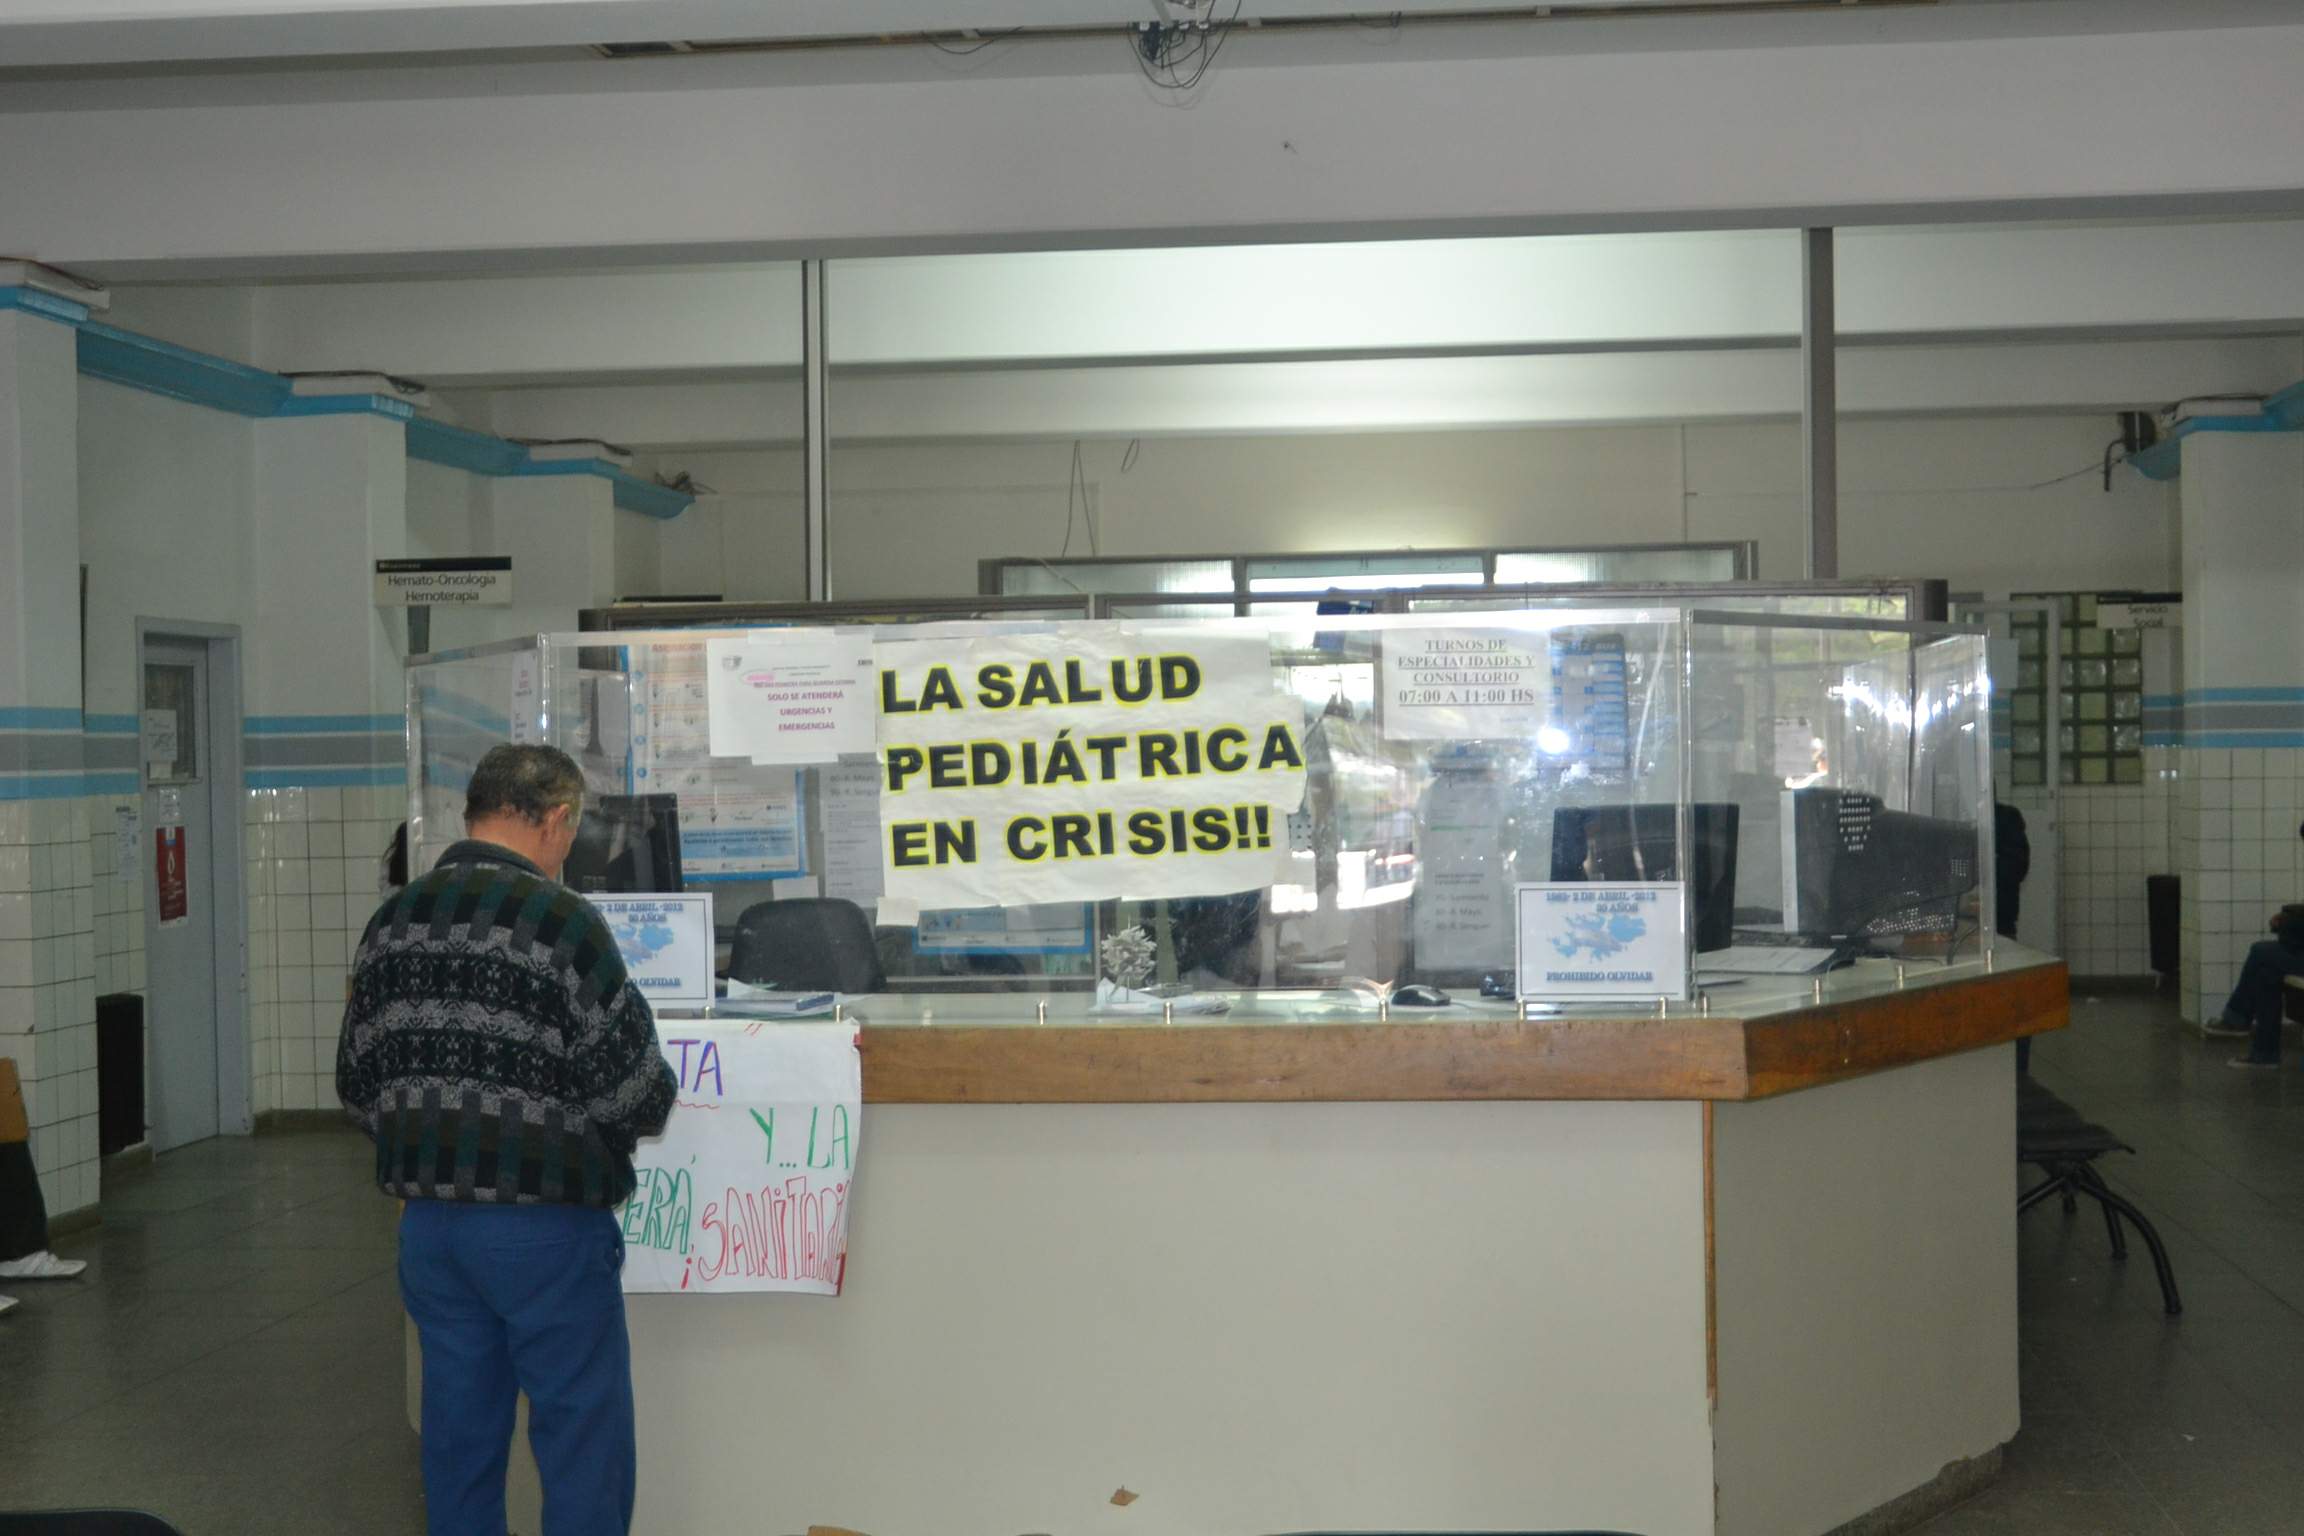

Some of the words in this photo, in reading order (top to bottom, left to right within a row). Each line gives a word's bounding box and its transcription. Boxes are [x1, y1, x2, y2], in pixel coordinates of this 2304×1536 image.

[405, 590, 480, 604] Hemoterapia
[1425, 639, 1484, 650] TURNOS
[1487, 638, 1507, 649] DE
[1525, 655, 1535, 666] Y
[1413, 671, 1520, 683] CONSULTORIO
[880, 665, 965, 715] LA
[975, 653, 1202, 711] SALUD
[767, 692, 789, 701] SOLO
[791, 692, 800, 700] SE
[1399, 689, 1441, 703] 07:00
[1446, 689, 1458, 703] A
[1465, 688, 1505, 702] 11:00
[1511, 688, 1535, 702] HS
[780, 707, 825, 716] URGENCIAS
[778, 721, 836, 731] EMERGENCIAS
[886, 724, 1304, 792] PEDIÁTRICA
[890, 817, 979, 868] EN
[1006, 803, 1273, 862] CRISIS!!
[1580, 892, 1596, 901] DE
[1598, 892, 1629, 901] ABRIL
[614, 903, 627, 912] DE
[630, 903, 658, 911] ABRIL
[1608, 901, 1639, 912] AÑOS
[639, 977, 681, 986] OLVIDAR
[1546, 972, 1605, 982] PROHIBIDO
[1607, 971, 1653, 981] OLVIDAR
[667, 1039, 723, 1096] TA
